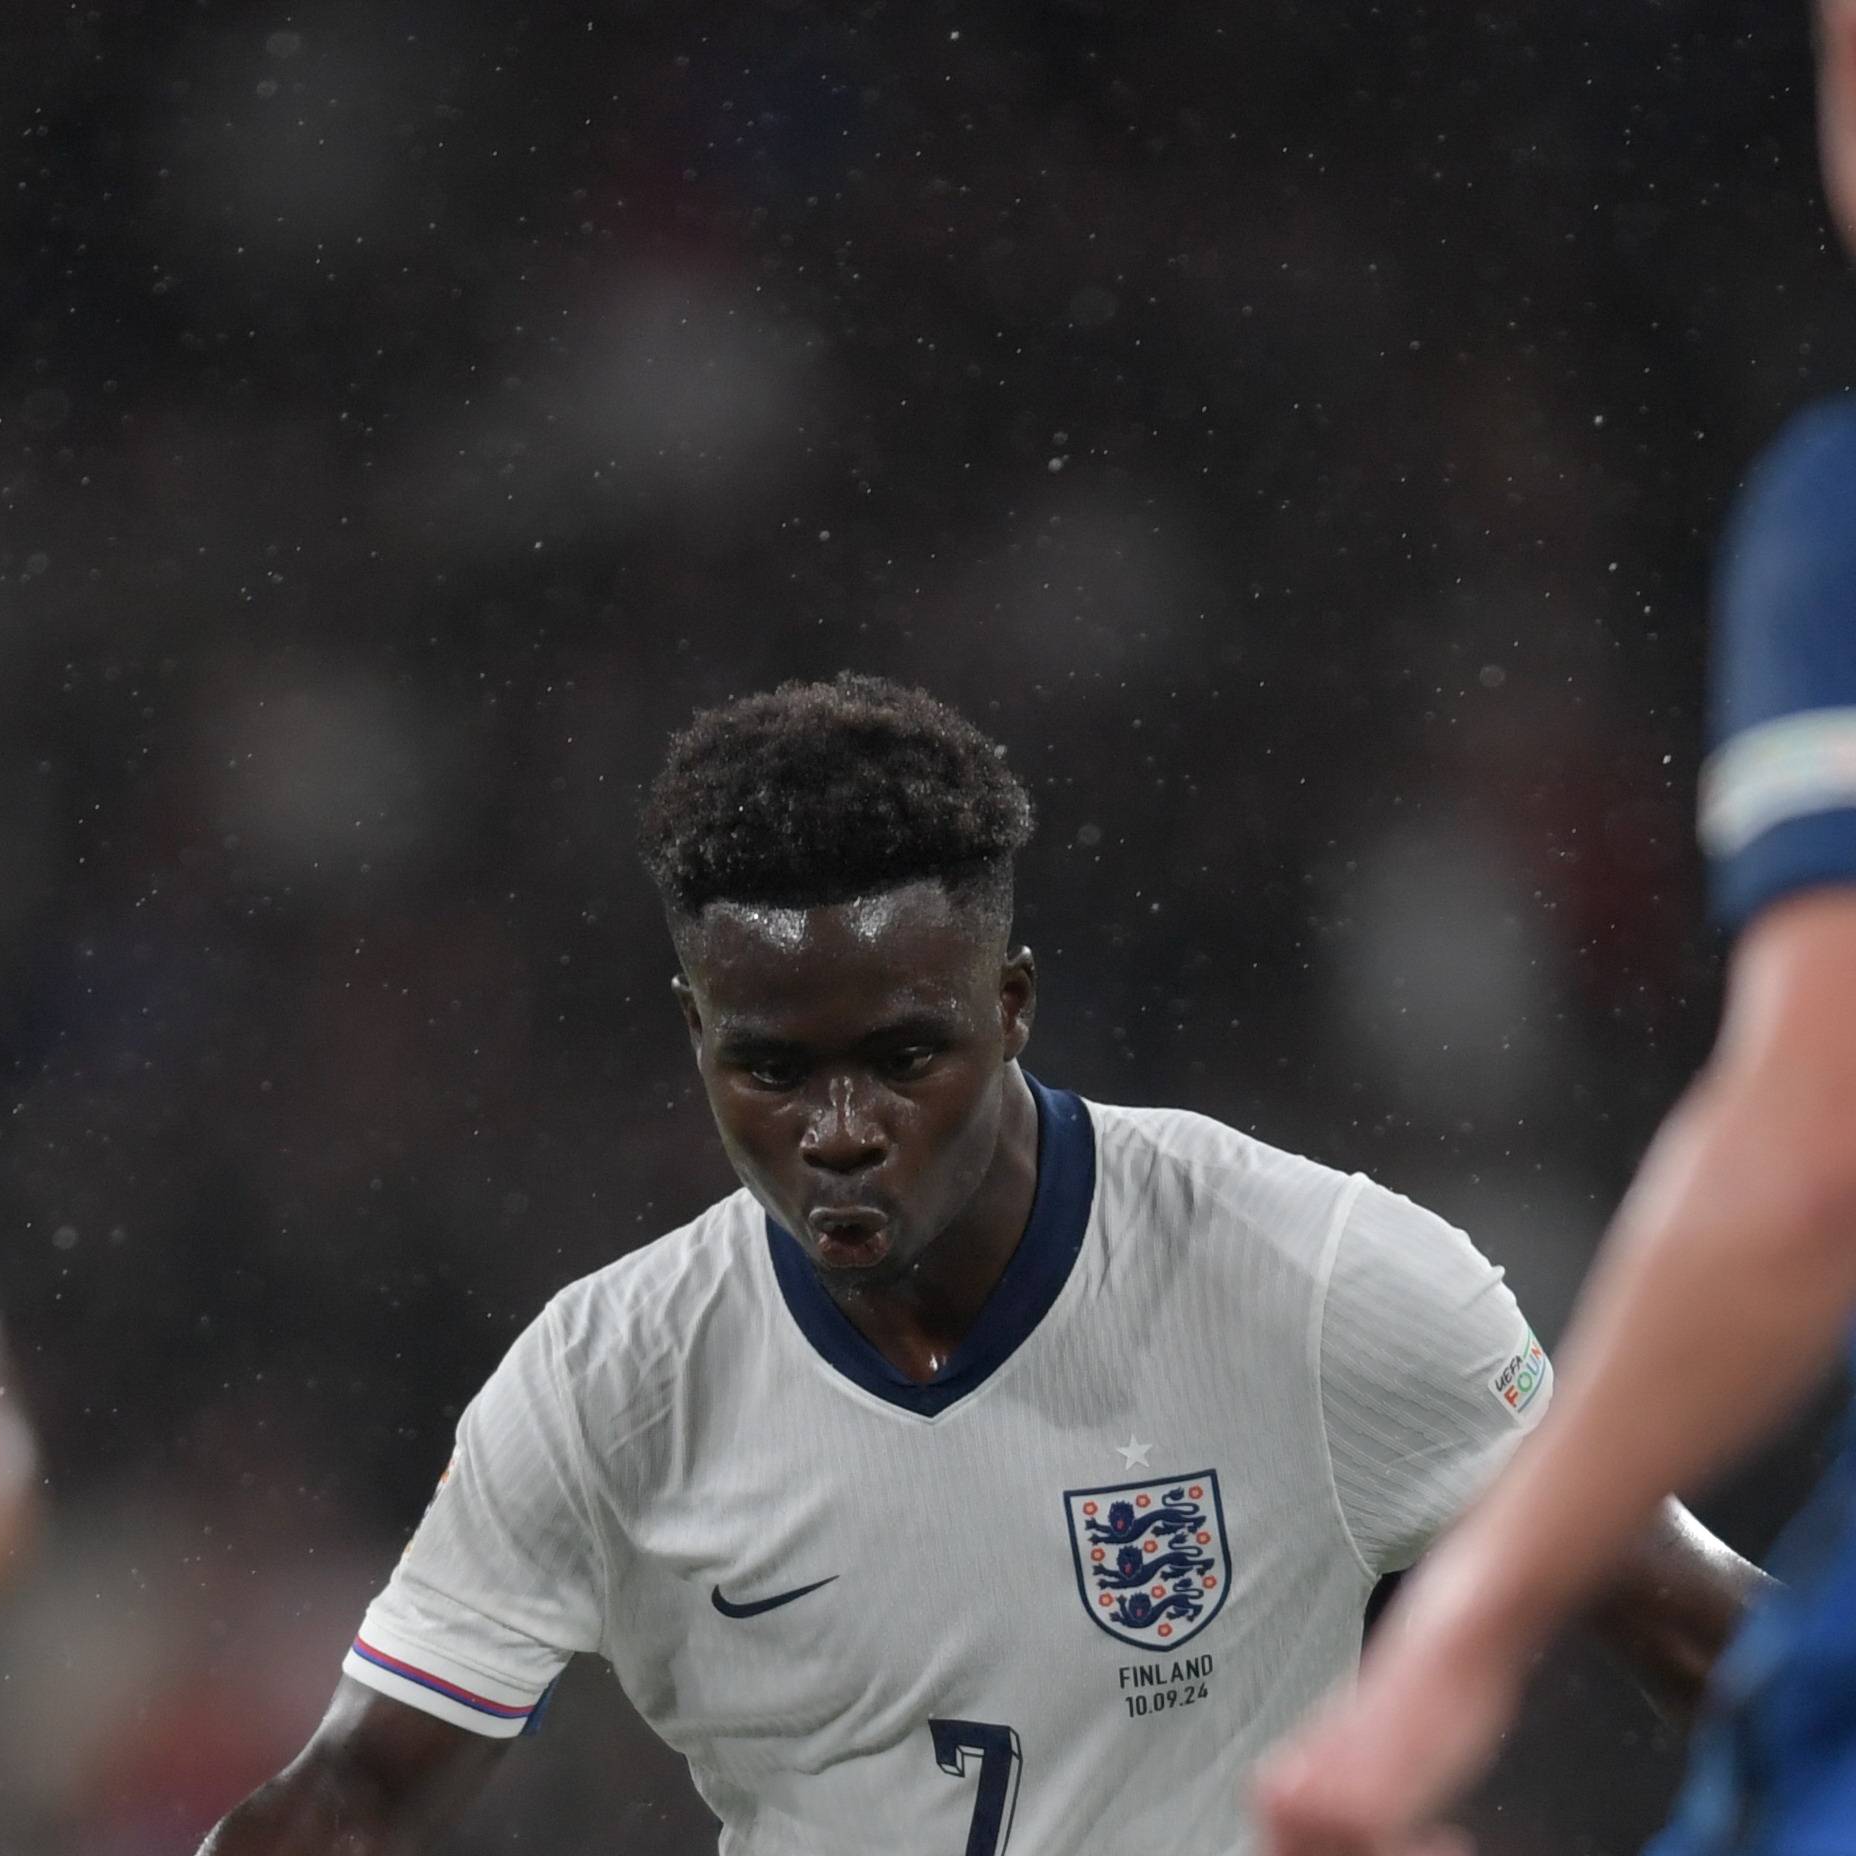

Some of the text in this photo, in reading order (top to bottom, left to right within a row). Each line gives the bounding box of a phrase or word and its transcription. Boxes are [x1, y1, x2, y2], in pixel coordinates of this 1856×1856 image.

[1494, 1355, 1523, 1392] UEFA
[1119, 1654, 1213, 1688] FINLAND
[1125, 1682, 1208, 1718] 10.09.24
